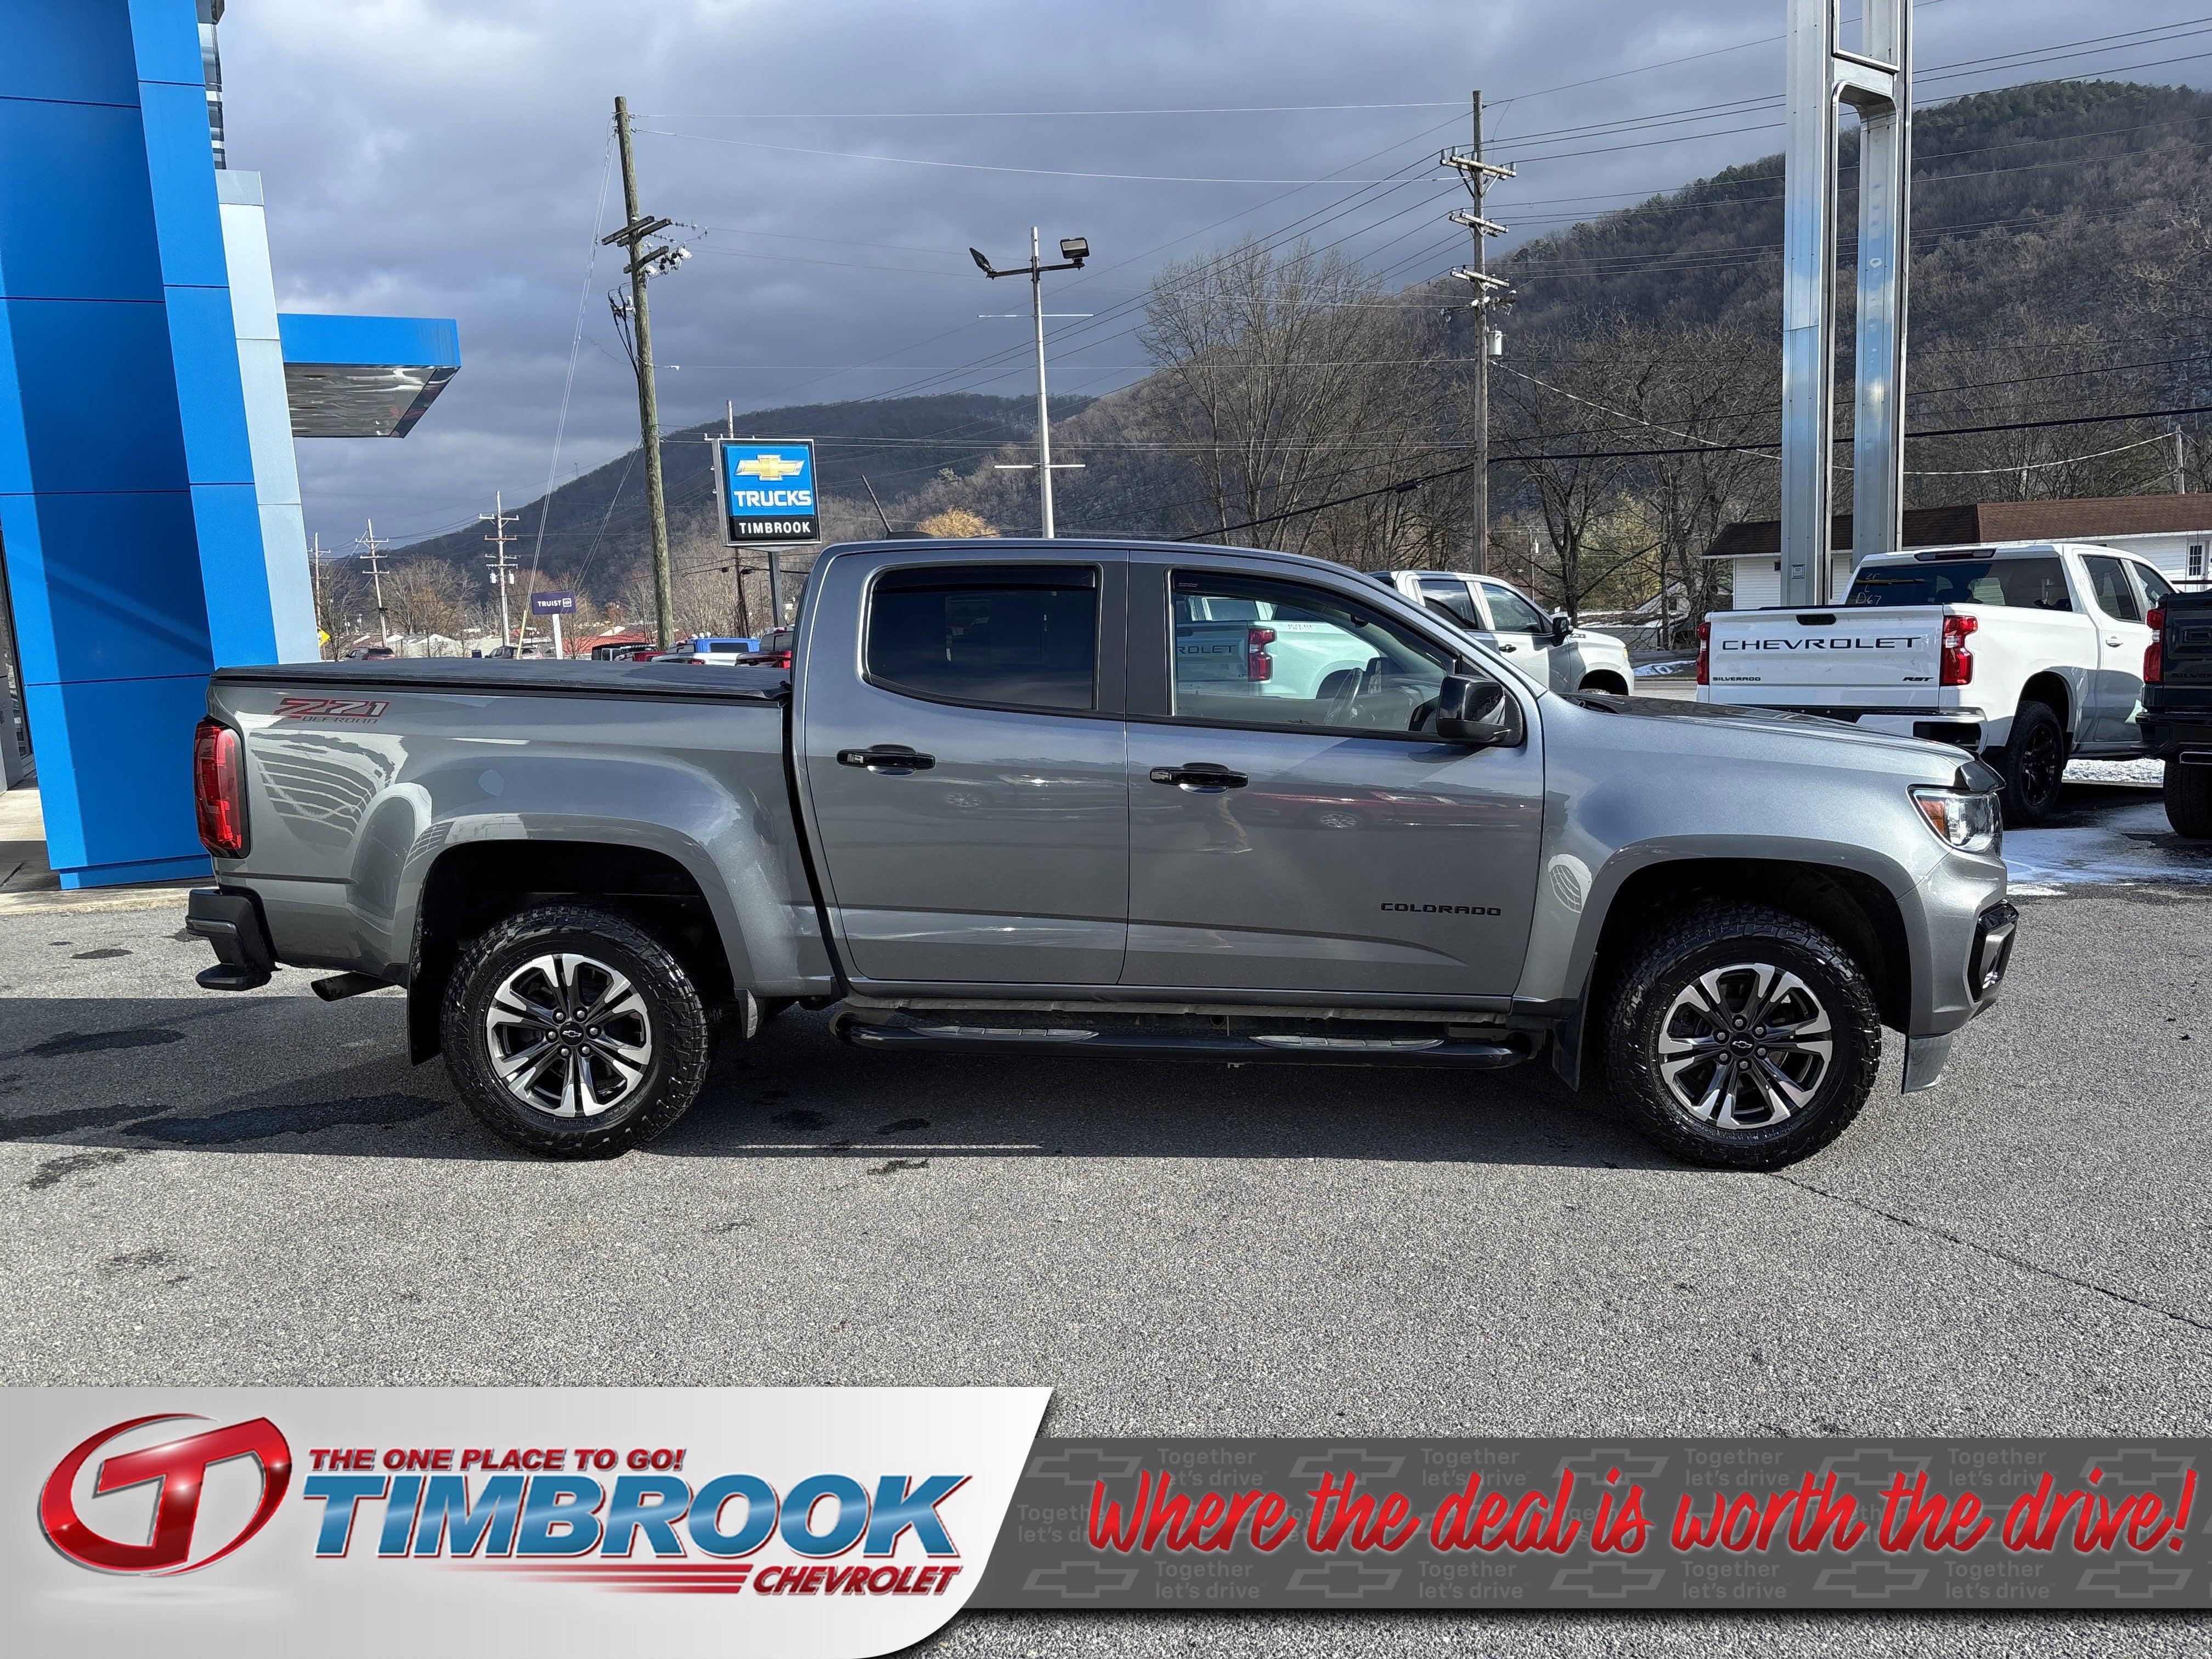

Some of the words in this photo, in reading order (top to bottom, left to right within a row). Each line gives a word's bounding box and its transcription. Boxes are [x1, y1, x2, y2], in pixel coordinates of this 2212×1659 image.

[734, 490, 811, 507] TRUCKS
[739, 522, 811, 534] TIMBROOK
[1723, 636, 1921, 651] CHEVROLET
[270, 697, 391, 720] Z71
[1381, 902, 1502, 916] COLORADO
